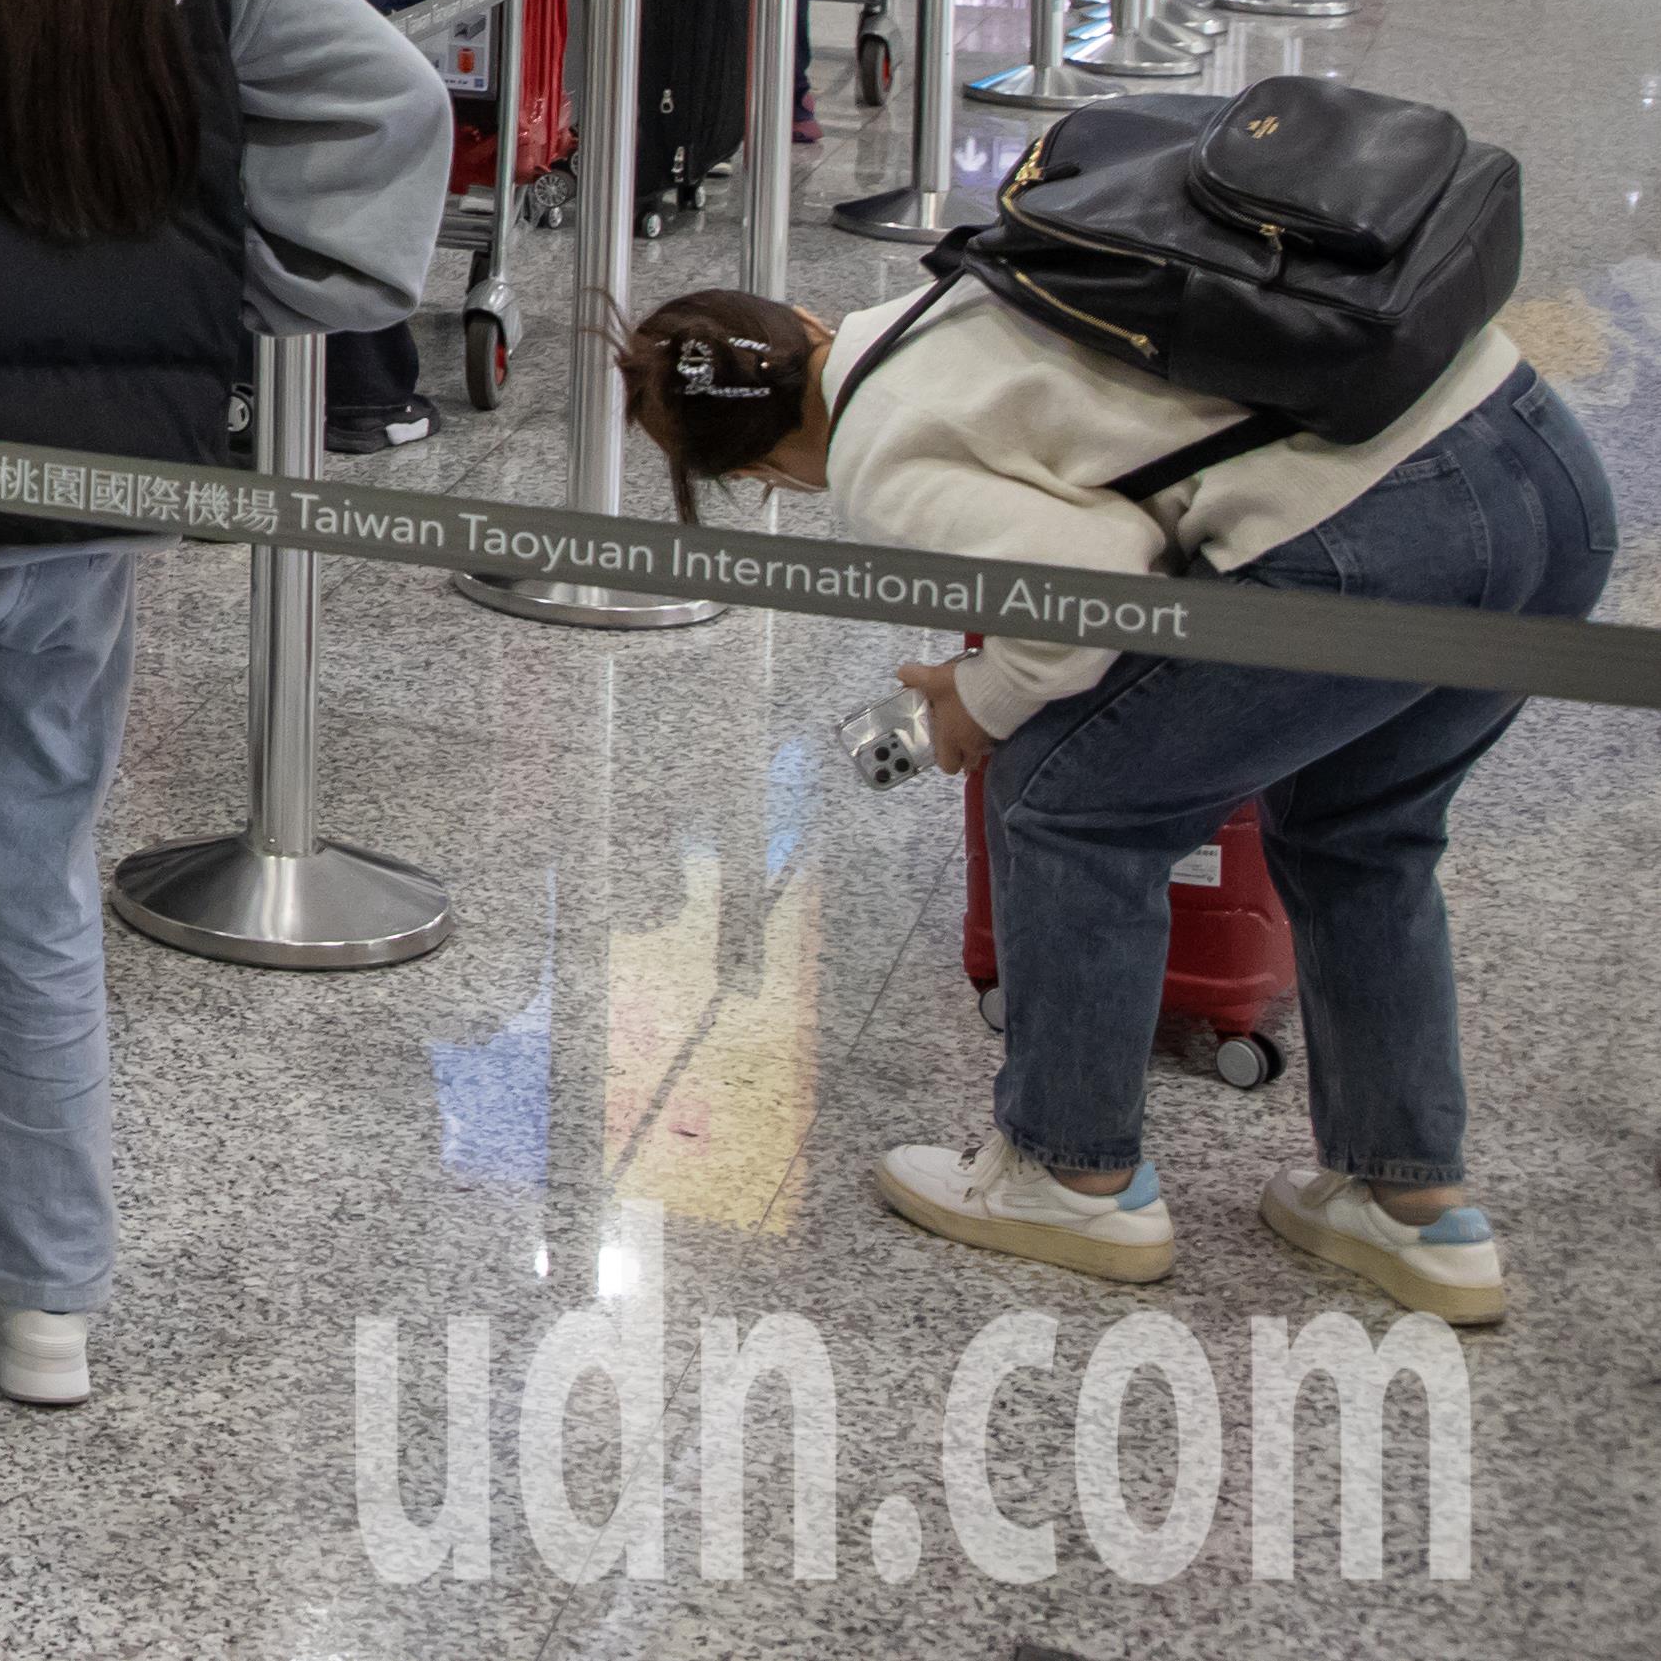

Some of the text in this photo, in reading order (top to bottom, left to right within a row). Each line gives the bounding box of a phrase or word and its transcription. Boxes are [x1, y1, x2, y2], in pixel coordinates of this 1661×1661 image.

[289, 490, 446, 548] Taiwan
[457, 512, 654, 578] Taoyuan
[672, 537, 985, 615] International
[998, 578, 1190, 639] Airport
